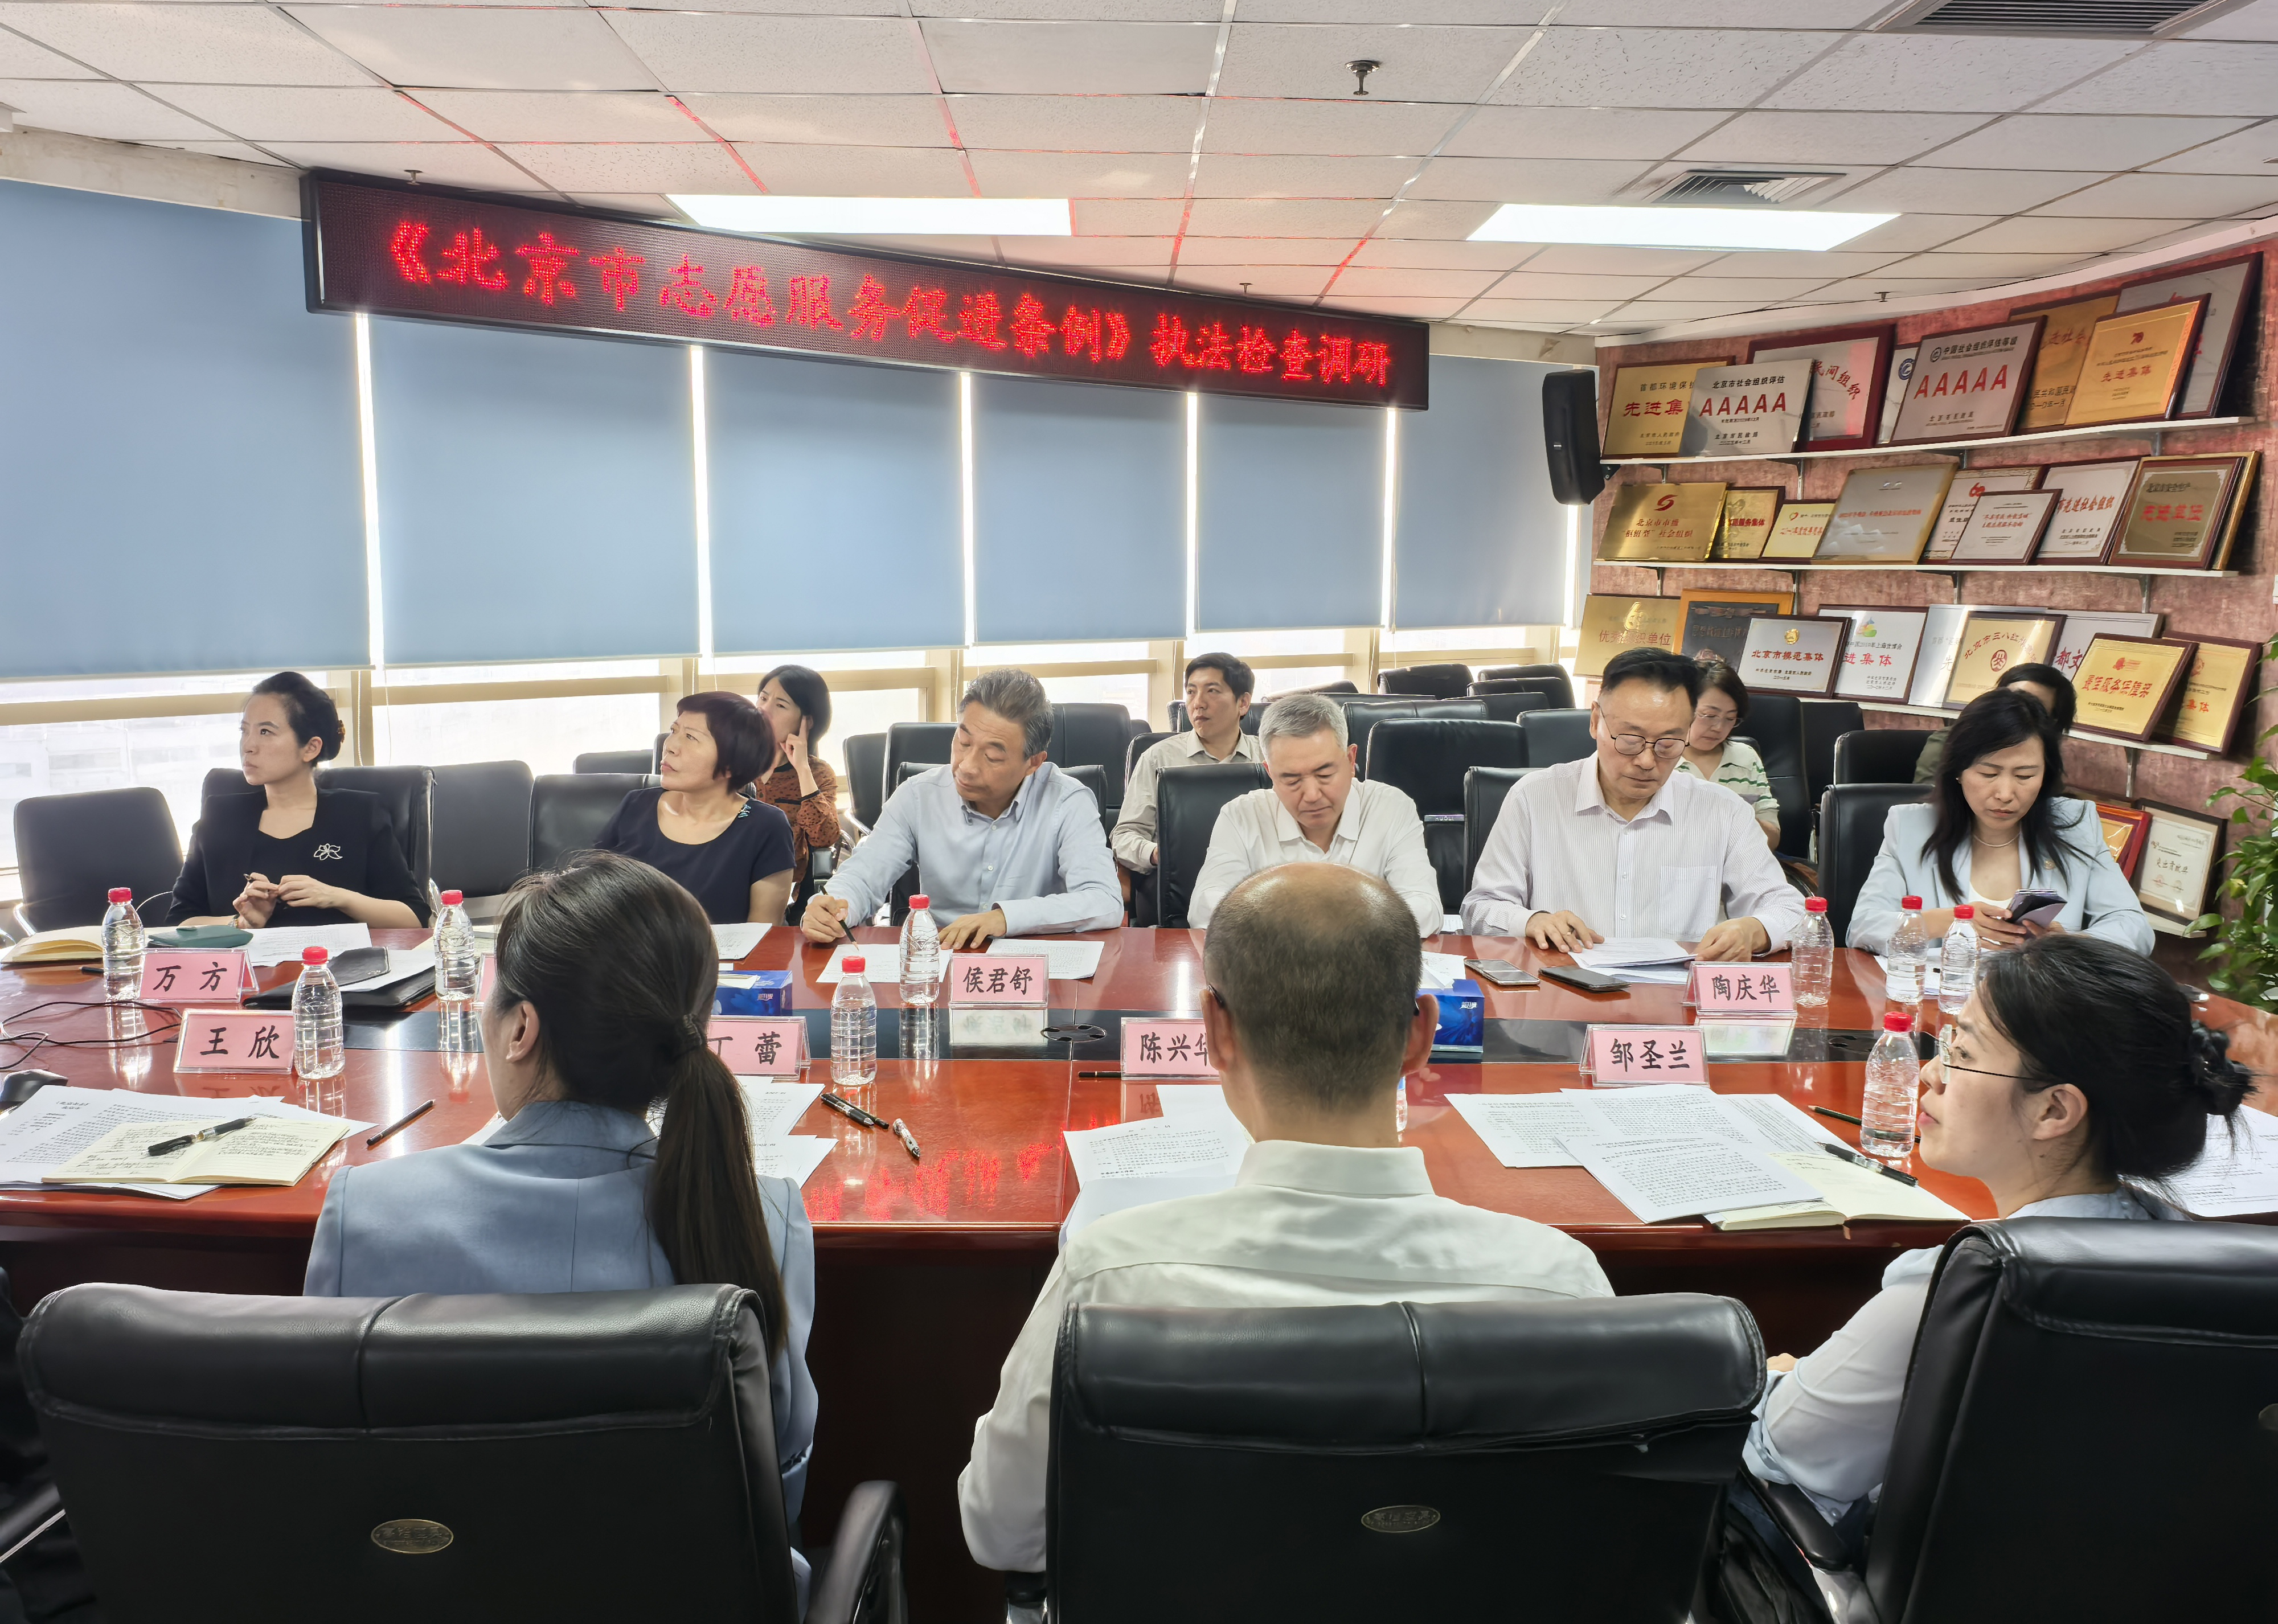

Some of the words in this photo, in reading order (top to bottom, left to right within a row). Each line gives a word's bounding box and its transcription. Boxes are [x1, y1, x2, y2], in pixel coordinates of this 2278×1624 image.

[390, 222, 1391, 386] 《北京市志愿服务促进条例》执法检查调研
[1712, 376, 1785, 388] 北京市社会组织评估
[1914, 364, 2008, 399] AAAAA
[1623, 399, 1690, 417] 先进集
[1699, 392, 1786, 417] AAAAA
[1751, 650, 1824, 662] 北京市模范集体
[1845, 653, 1892, 667] 进集体
[2054, 646, 2084, 671] 都文
[2082, 675, 2153, 699] 最佳服务保障奖
[153, 962, 228, 992] 万方
[963, 966, 1033, 995] 侯君舒
[1712, 974, 1780, 1003] 陶庆华
[200, 1025, 280, 1059] 王欣
[712, 1032, 782, 1065] 丁蕾
[1610, 1038, 1690, 1072] 邹圣兰
